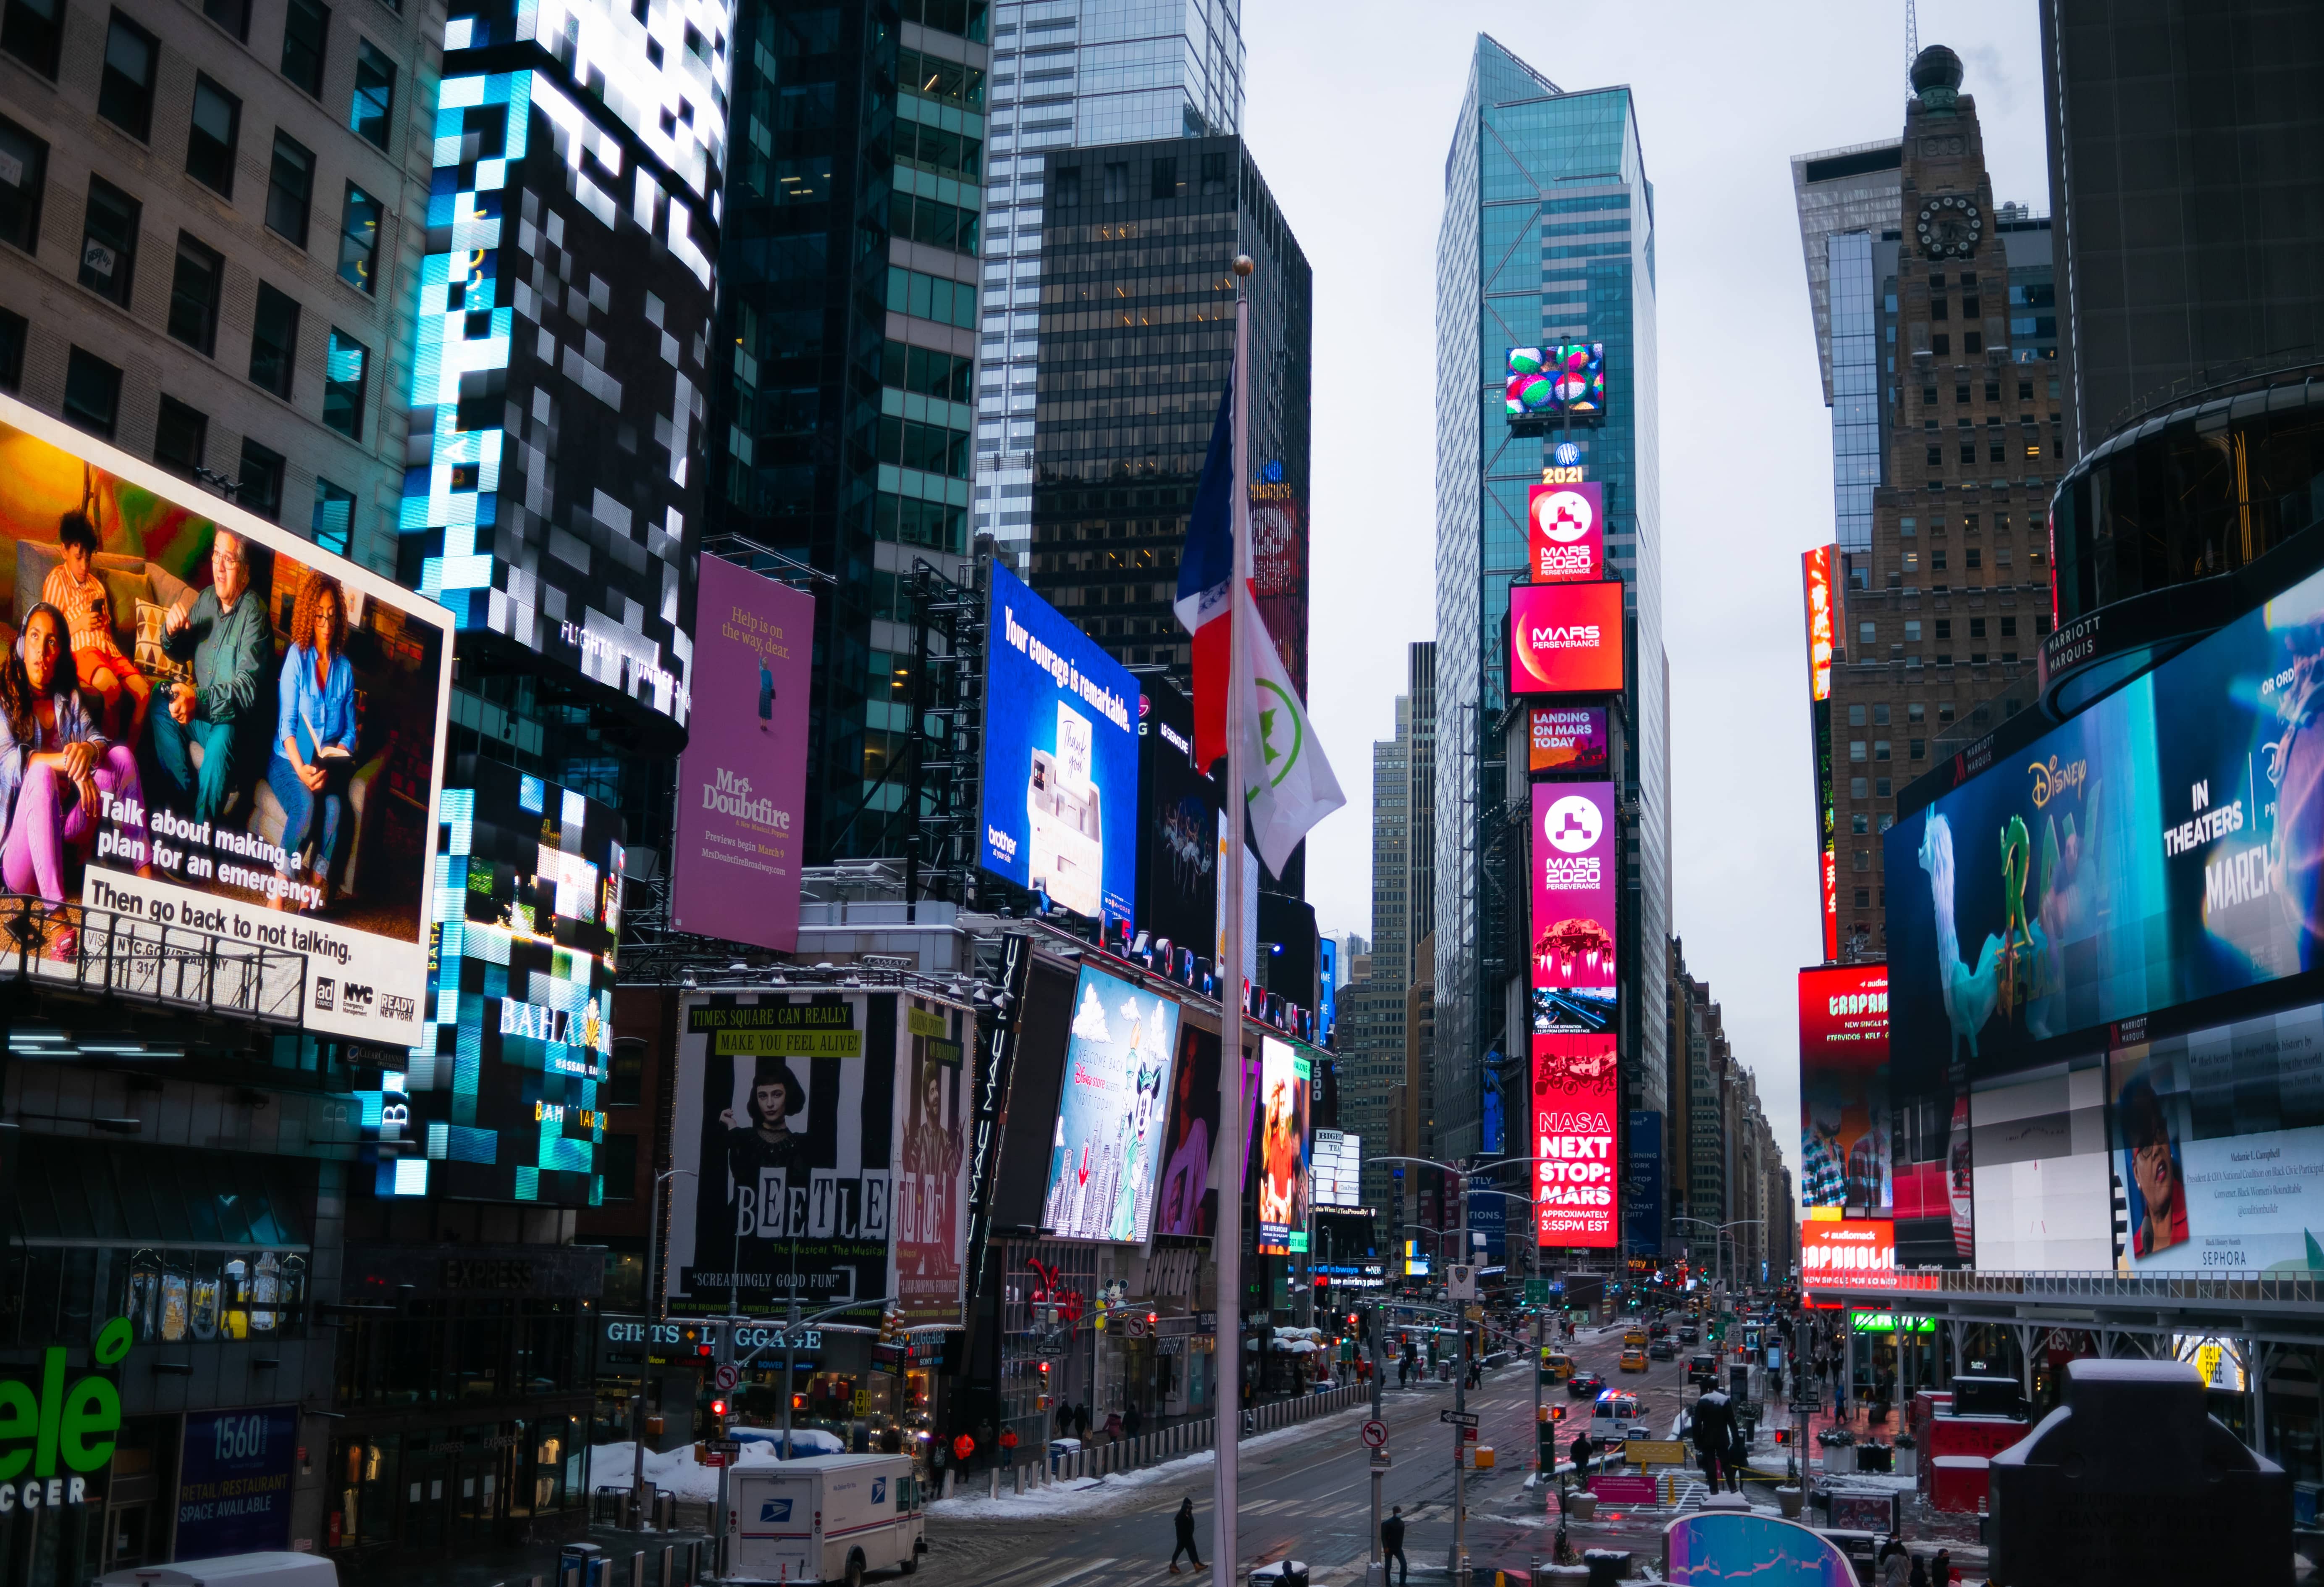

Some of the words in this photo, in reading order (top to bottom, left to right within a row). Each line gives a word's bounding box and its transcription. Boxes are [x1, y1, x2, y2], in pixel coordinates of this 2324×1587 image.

[1543, 467, 1583, 484] 2021
[1541, 545, 1590, 557] MARS
[1541, 556, 1591, 570] 2020
[732, 606, 757, 632] Help
[759, 617, 768, 633] is
[770, 625, 783, 639] on
[722, 622, 739, 640] the
[742, 631, 763, 652] way,
[766, 638, 790, 659] dear.
[1533, 625, 1600, 641] MARS
[2049, 616, 2100, 654] MARRIOTT
[1533, 640, 1600, 649] PERSEVERANCE
[561, 620, 612, 662] FLIGHTS
[636, 656, 673, 694] UNDER
[2050, 640, 2093, 673] MARQUIS
[1005, 605, 1028, 654] Your
[1030, 636, 1069, 688] courage
[1070, 658, 1078, 693] is
[1080, 675, 1130, 733] remarkable.
[2262, 679, 2274, 695] OR
[1534, 712, 1590, 723] LANDING
[1062, 720, 1087, 759] Thank
[1162, 723, 1167, 737] LG
[1167, 728, 1188, 754] SIGNATURE
[1534, 725, 1552, 736] ON
[1555, 725, 1592, 735] MARS
[1534, 737, 1575, 748] TODAY
[1967, 735, 1994, 758] MARRIOTT
[1069, 757, 1083, 778] you
[1968, 753, 1991, 773] MARQUIS
[716, 767, 752, 795] Mrs.
[2192, 778, 2209, 812] IN
[703, 783, 790, 830] Doubtfire
[100, 791, 144, 827] Talk
[151, 809, 210, 845] about
[215, 830, 285, 870] making
[291, 851, 302, 870] a
[2164, 800, 2243, 857] THEATERS
[706, 830, 736, 846] Previews
[738, 838, 756, 852] begin
[758, 844, 779, 857] March
[780, 850, 784, 858] 9
[988, 824, 1016, 856] brother
[97, 831, 144, 861] plan
[152, 843, 182, 869] for
[187, 855, 212, 878] an
[218, 863, 324, 909] emergency.
[702, 848, 786, 875] MrsDoubtfireBroadway.com
[1546, 857, 1600, 869] MARS
[1546, 868, 1600, 883] 2020
[91, 878, 142, 914] Then
[149, 899, 174, 922] go
[181, 900, 227, 933] back
[233, 914, 251, 938] to
[257, 922, 287, 951] not
[291, 926, 352, 965] talking.
[137, 961, 155, 976] 311
[317, 982, 334, 1001] ad
[344, 982, 373, 1004] NYC
[343, 1001, 364, 1010] Emergency
[343, 1007, 367, 1017] Management
[382, 994, 414, 1013] READY
[380, 1009, 394, 1019] NEW
[397, 1012, 413, 1022] YORK
[692, 1009, 726, 1026] TIMES
[729, 1008, 774, 1028] SQUARE
[778, 1008, 800, 1024] CAN
[805, 1007, 849, 1024] REALLY
[911, 1012, 927, 1032] RAISING
[929, 1018, 943, 1037] SPIRITS
[2122, 1018, 2147, 1032] MARRIOTT
[721, 1034, 754, 1050] MAKE
[759, 1034, 782, 1050] YOU
[787, 1035, 815, 1050] FEEL
[820, 1035, 858, 1051] ALIVE!
[2122, 1031, 2145, 1043] MARQUIS
[930, 1041, 935, 1056] ON
[936, 1042, 960, 1062] BROADWAY!
[1078, 1048, 1106, 1067] WELCOME
[1110, 1057, 1123, 1072] BACK
[556, 1059, 587, 1075] NASSAU,
[1093, 1077, 1105, 1089] store
[1313, 1059, 1321, 1101] 1500
[1076, 1092, 1091, 1106] VISIT
[1539, 1113, 1611, 1133] NASA
[1540, 1136, 1612, 1158] NEXT
[2231, 1152, 2250, 1161] Melanie
[2256, 1148, 2280, 1161] Campbell
[1540, 1162, 1611, 1182] STOP:
[2187, 1173, 2206, 1183] President
[2223, 1170, 2242, 1180] National
[2243, 1169, 2264, 1179] Coalition
[2272, 1167, 2285, 1176] Black
[2285, 1165, 2298, 1175] Civic
[1541, 1186, 1611, 1205] MARS
[2237, 1187, 2248, 1197] Black
[2251, 1185, 2272, 1196] Women's
[2273, 1183, 2301, 1194] Roundtable
[735, 1176, 884, 1238] BEETLE
[1542, 1220, 1584, 1231] 3:55PM
[1588, 1220, 1609, 1231] EST
[1831, 1231, 1875, 1240] audiomack
[773, 1243, 788, 1254] The
[792, 1244, 829, 1255] Musical.
[833, 1245, 849, 1255] The
[852, 1246, 887, 1257] Musical.
[2203, 1251, 2246, 1265] SEPHORA
[446, 1260, 532, 1289] EXPRESS
[776, 1274, 806, 1287] GOOD
[905, 1280, 934, 1293] JAW-DROPPING
[608, 1323, 679, 1344] GIFTS
[911, 1332, 945, 1345] LUGGAGE
[674, 1357, 706, 1366] Canon
[758, 1361, 784, 1369] BOWER
[2206, 1362, 2222, 1383] FREE
[214, 1415, 260, 1460] 1560
[483, 1435, 517, 1449] EXPRESS
[428, 1441, 464, 1455] EXPRESS
[182, 1474, 288, 1501] RETAIL/RESTAURANT
[180, 1503, 214, 1523] SPACE
[217, 1495, 272, 1518] AVAILABLE
